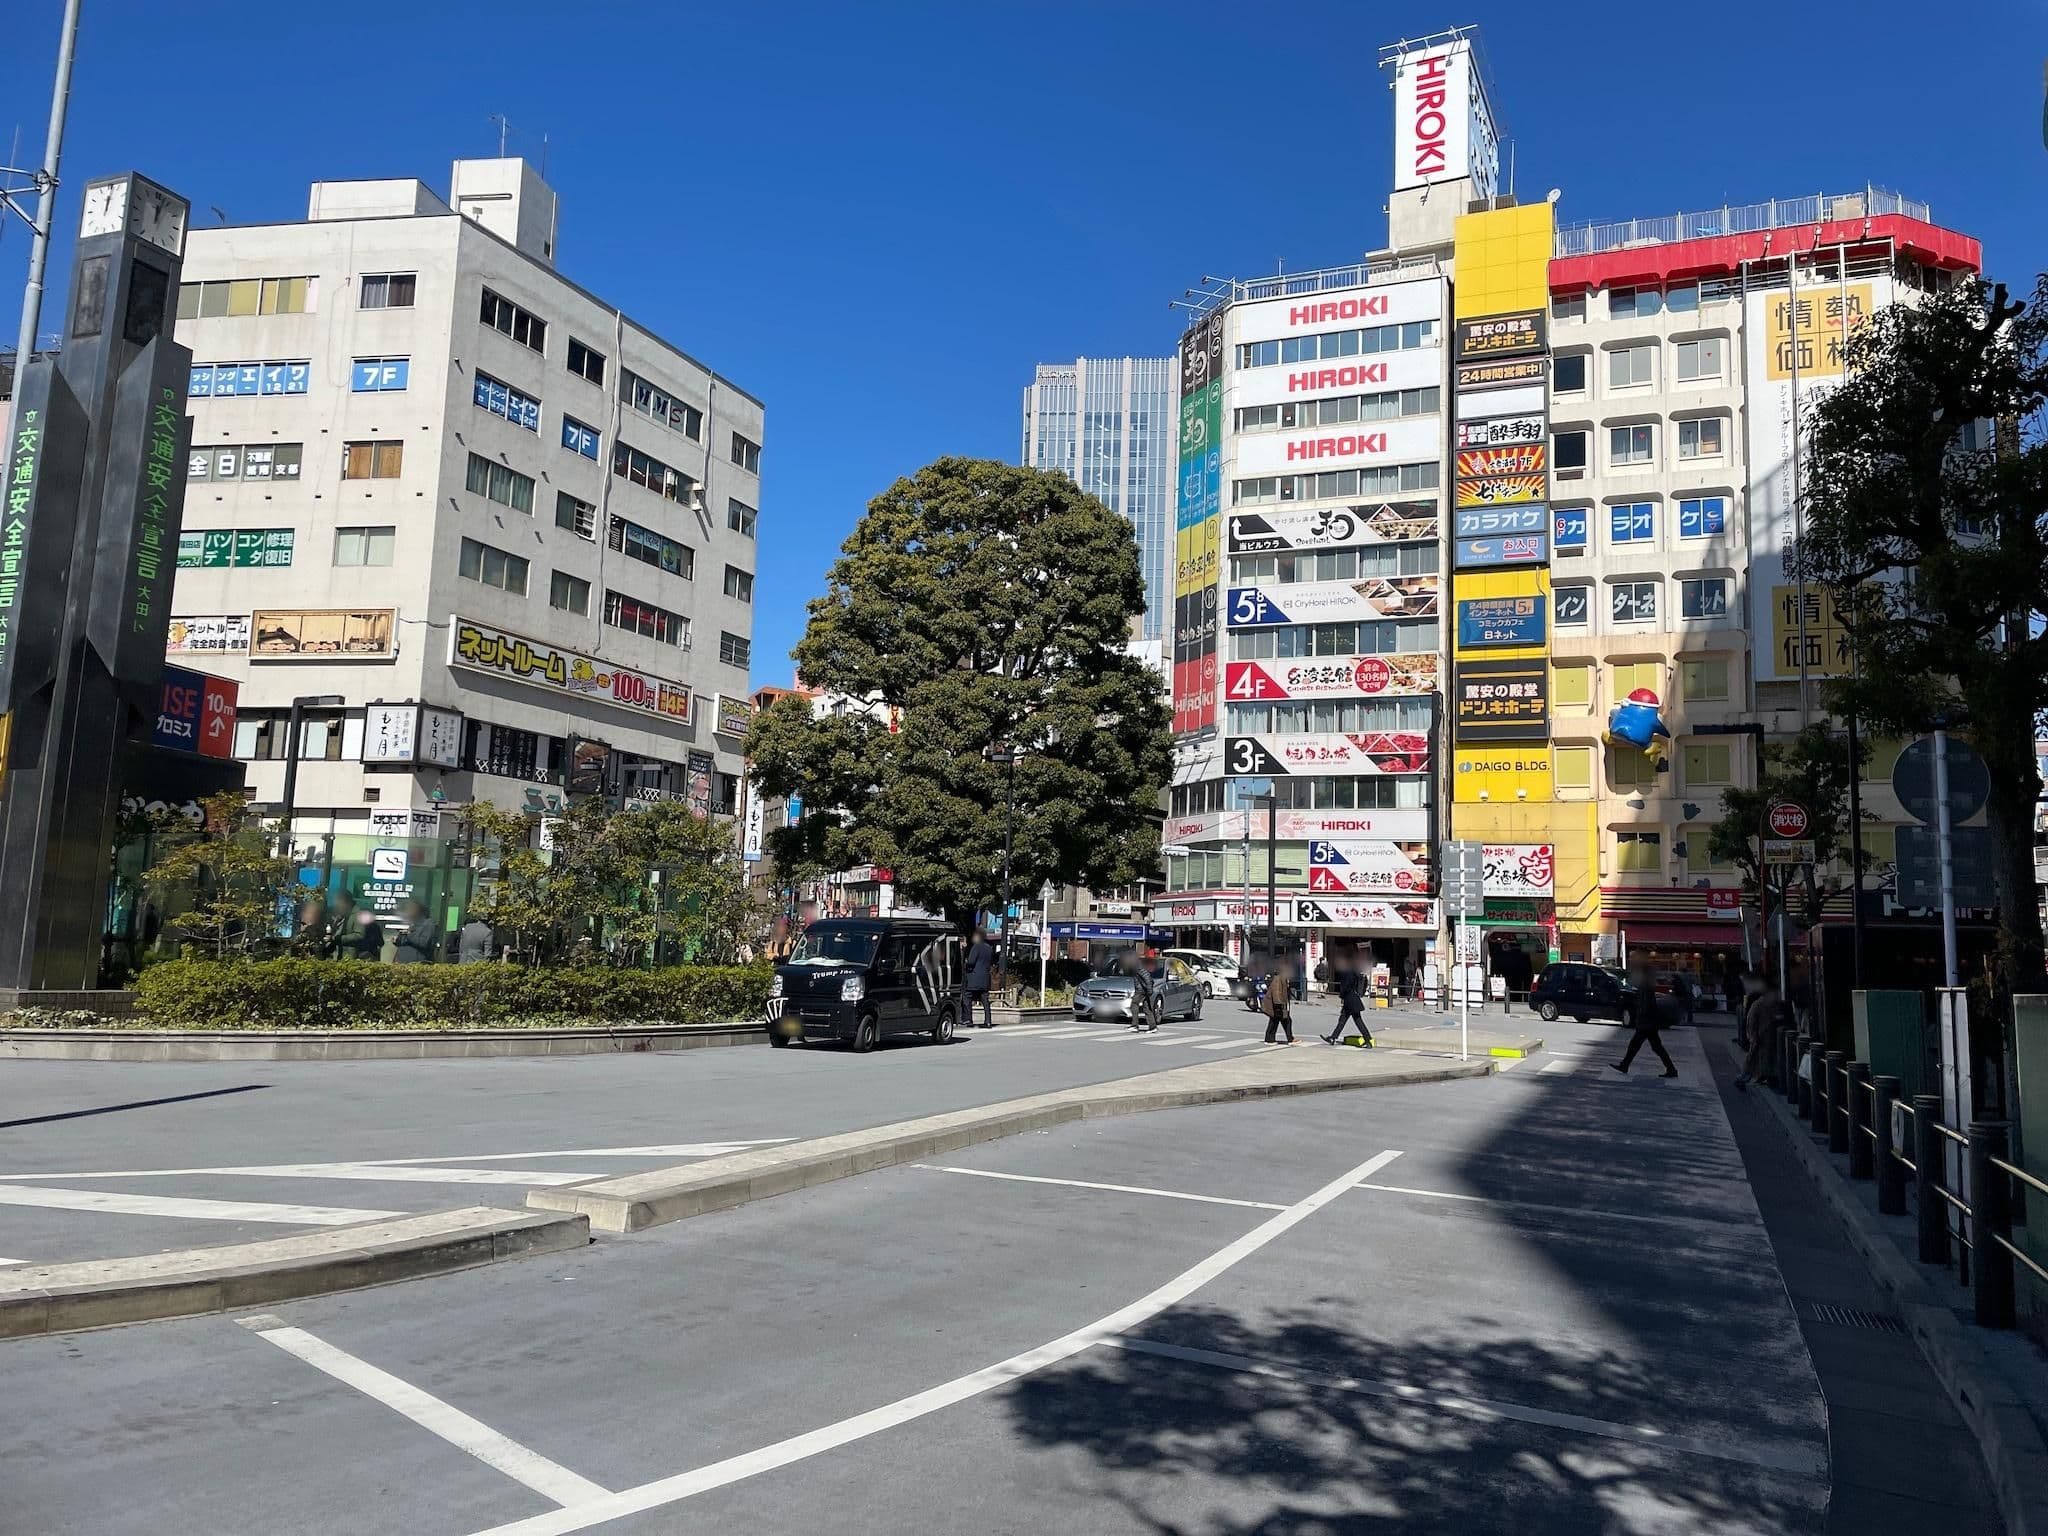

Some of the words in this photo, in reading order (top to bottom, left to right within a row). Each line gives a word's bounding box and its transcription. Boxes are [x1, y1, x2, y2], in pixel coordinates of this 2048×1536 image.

[1416, 55, 1446, 176] HIROKI
[1290, 296, 1388, 325] HIROKI
[363, 367, 397, 386] 7F
[1289, 363, 1388, 392] HIROKI
[569, 427, 592, 450] 7F
[1287, 433, 1387, 460] HIROKI
[188, 454, 236, 476] 全日
[136, 404, 179, 580] 交通安全宣言
[0, 428, 38, 608] 交通安全宣言
[1461, 511, 1540, 531] カラオケ
[206, 532, 293, 548] パソコン修理
[204, 549, 292, 565] データ復旧
[459, 627, 567, 685] ネットルーム
[1230, 664, 1266, 698] 4F
[207, 693, 233, 716] 10m
[1232, 739, 1266, 773] 3F
[1475, 762, 1511, 771] DAIGO
[1515, 761, 1550, 771] BLDG.
[1179, 823, 1204, 836] HIROKI
[1321, 820, 1371, 831] HIROKI
[1773, 814, 1804, 827] 消火栓
[1313, 869, 1335, 890] 4F
[1172, 904, 1197, 916] HIROKI
[1300, 901, 1320, 921] 3F
